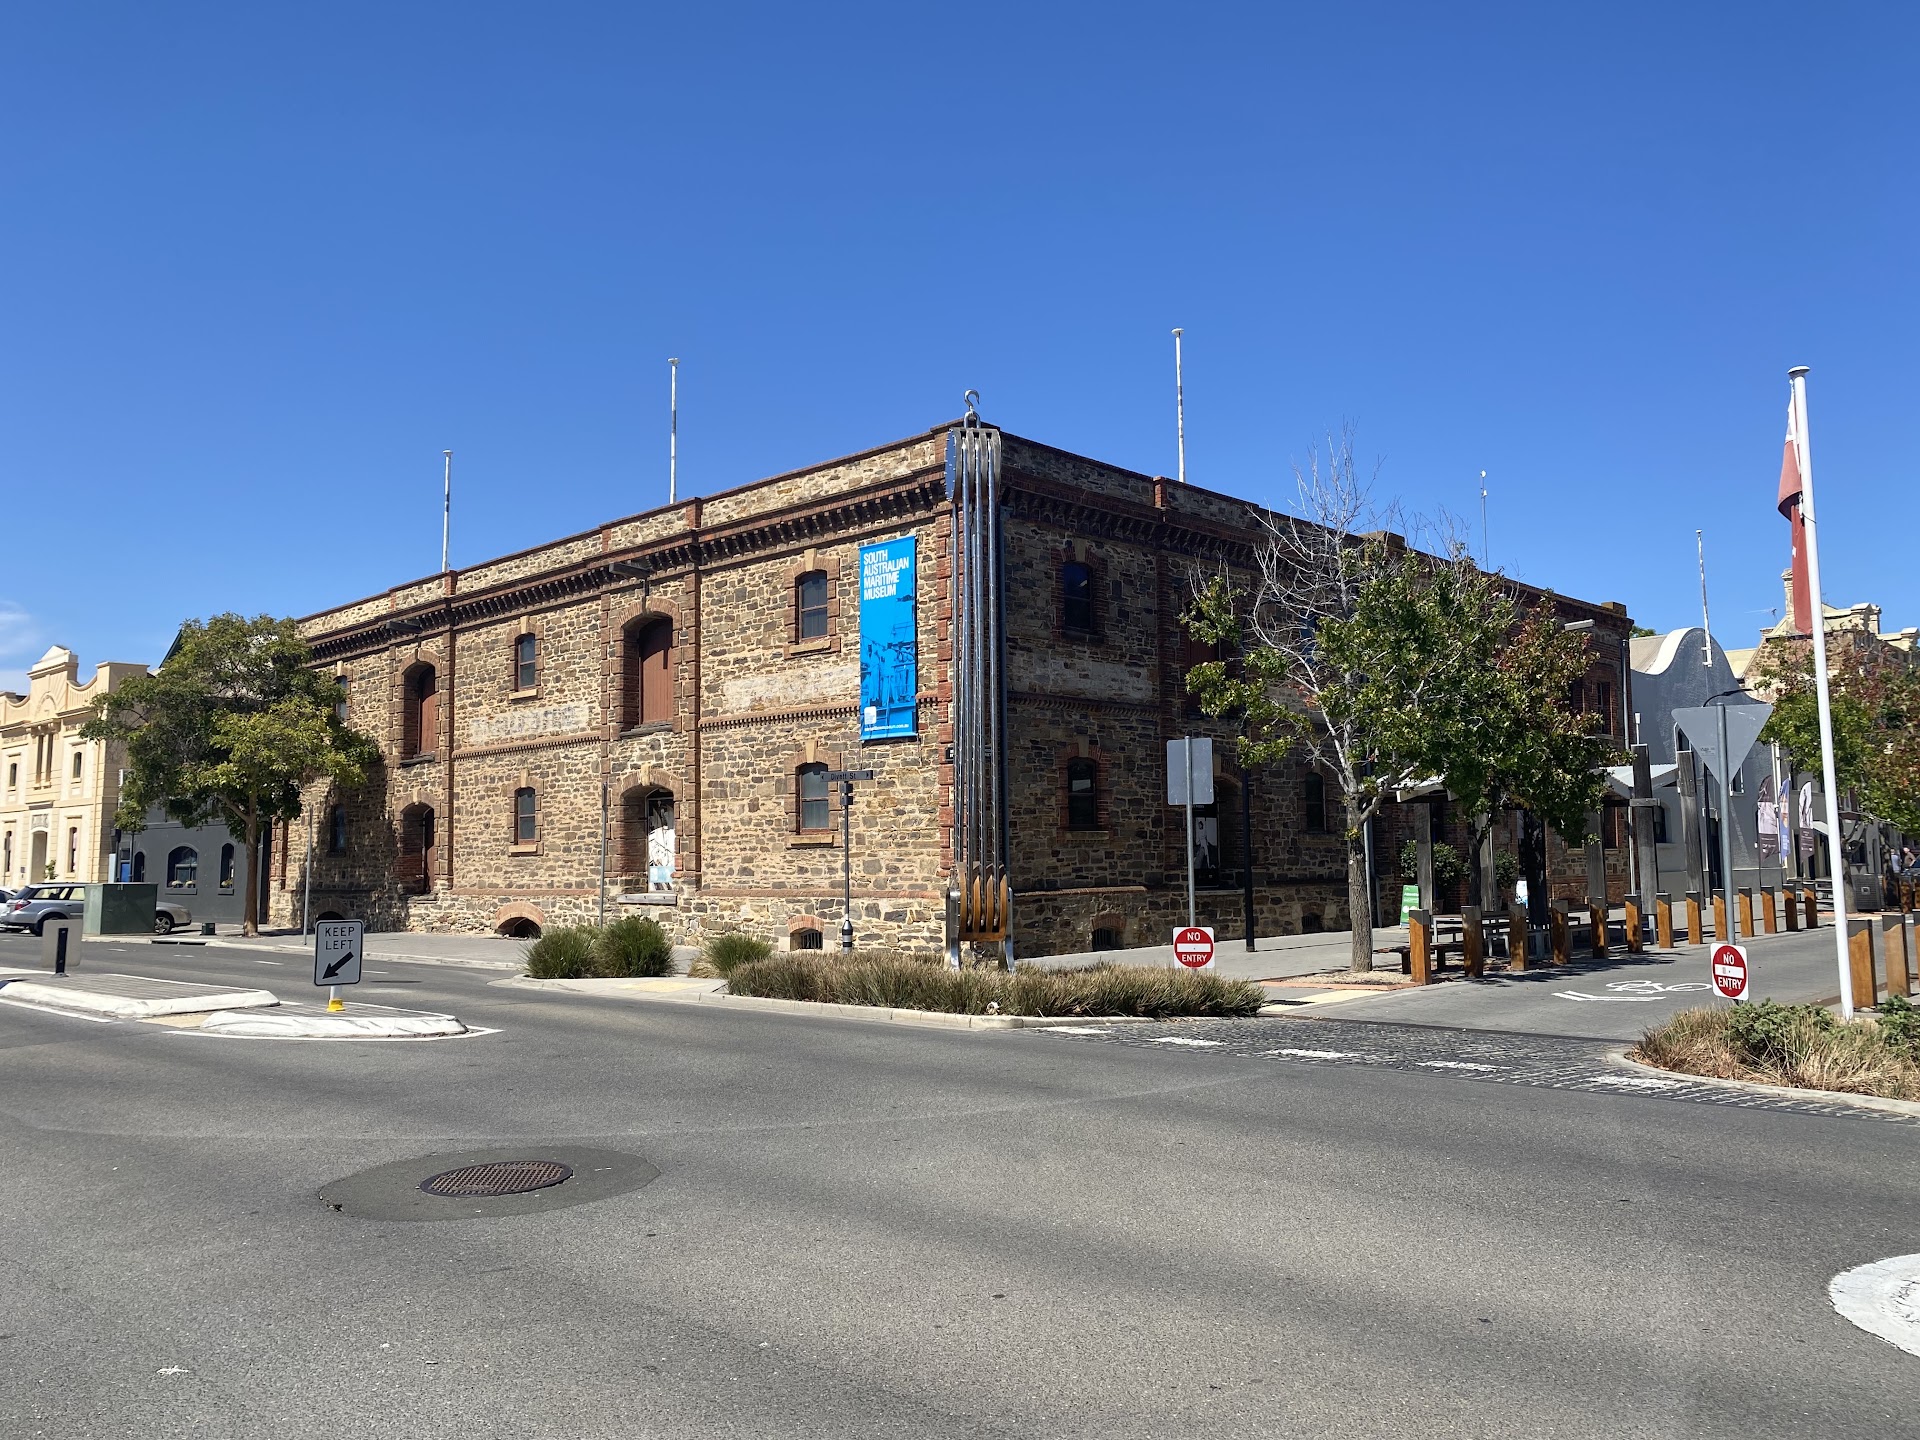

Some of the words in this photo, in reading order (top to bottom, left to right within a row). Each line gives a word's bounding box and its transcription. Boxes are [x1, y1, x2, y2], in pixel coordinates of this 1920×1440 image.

[863, 549, 888, 565] SOUTH
[863, 556, 910, 577] AUSTRALIAN
[863, 571, 900, 589] MARITIME
[863, 583, 897, 601] MUSEUM
[325, 926, 355, 937] KEEP
[1187, 931, 1201, 941] NO
[325, 940, 353, 950] LEFT
[1181, 954, 1207, 962] ENTRY
[1723, 953, 1735, 965] NO
[1718, 977, 1742, 990] ENTRY
